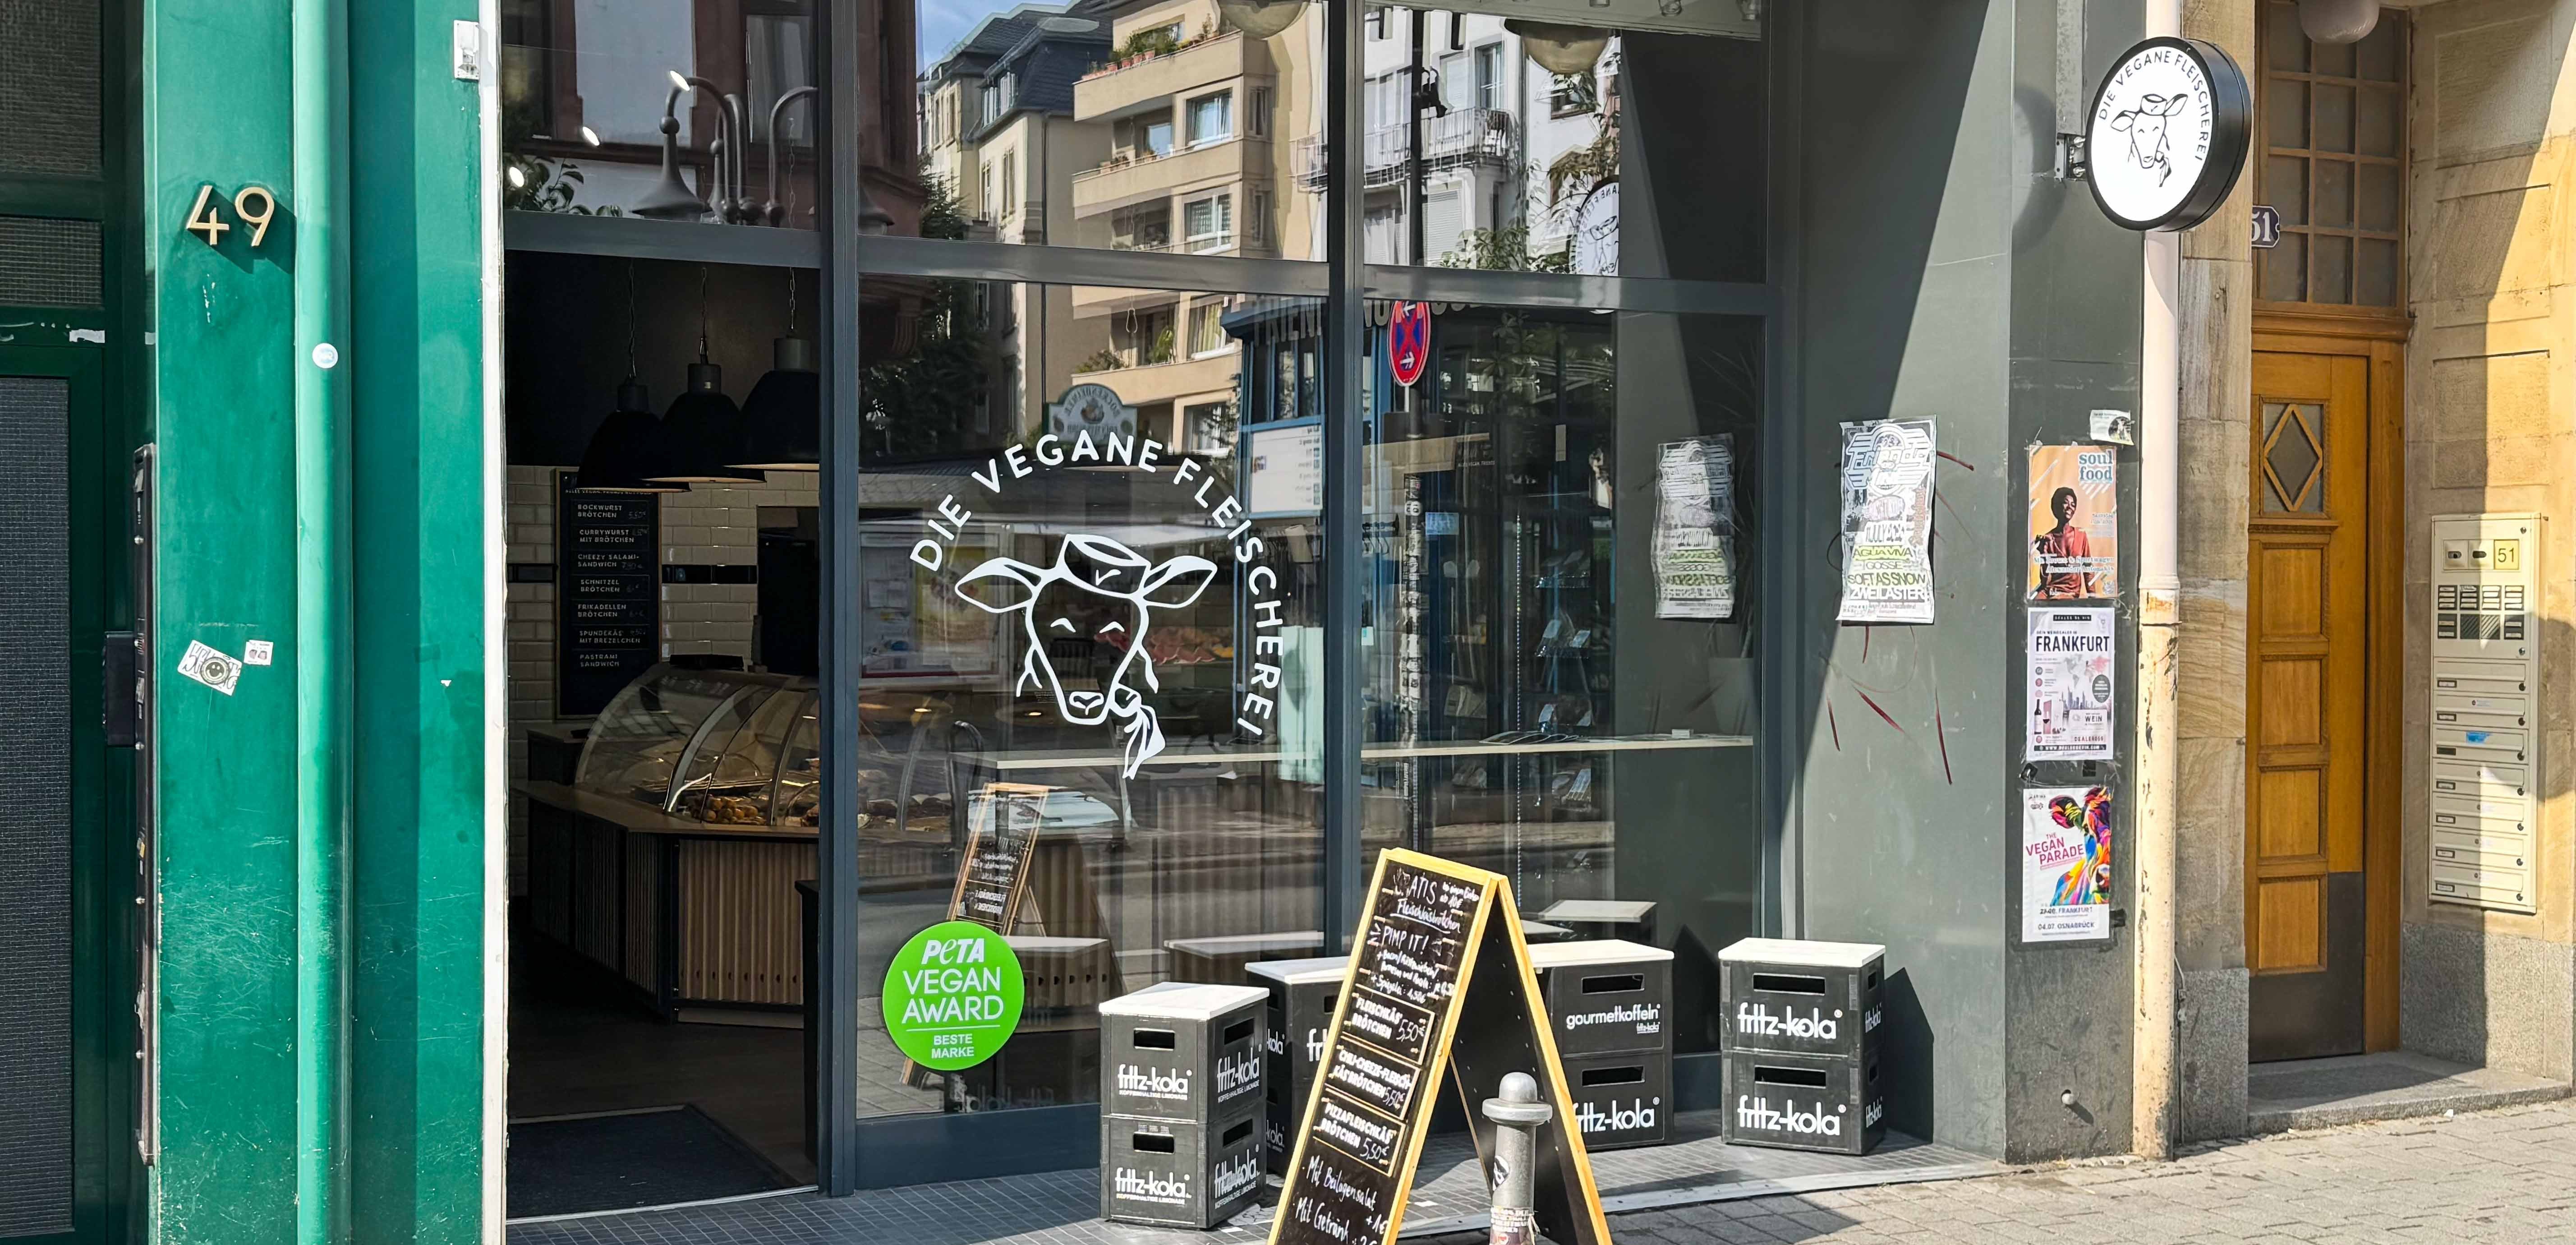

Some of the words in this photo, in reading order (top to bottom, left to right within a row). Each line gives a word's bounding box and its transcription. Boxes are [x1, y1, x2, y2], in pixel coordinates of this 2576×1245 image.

[2099, 90, 2116, 120] DIE
[2116, 50, 2171, 86] VEGANE
[2174, 54, 2210, 161] FLEISCHEREI
[187, 185, 275, 247] 49
[2251, 211, 2271, 242] 51
[2079, 450, 2113, 465] soul
[2079, 466, 2113, 482] food
[1853, 548, 1887, 558] AGUA
[1866, 561, 1904, 570] GOSSE
[2497, 547, 2515, 563] 51
[910, 494, 972, 572] DIE
[971, 429, 1163, 493] VEGANE
[1173, 457, 1283, 736] FLEISCHEREI
[2036, 636, 2110, 652] FRANKFURT
[2025, 837, 2065, 856] VEGAN
[2039, 844, 2084, 865] PARADE
[1381, 925, 1408, 950] PIMP
[2057, 921, 2095, 929] OSNABRÜCK
[902, 966, 1001, 995] VEGAN
[902, 995, 1004, 1024] AWARD
[1737, 1002, 1837, 1040] fritz-kola
[934, 1033, 973, 1046] BESTE
[1352, 1013, 1392, 1039] BRÖTCHEN
[931, 1046, 975, 1059] MARKE
[1118, 1063, 1189, 1094] fritz-kola
[1217, 1047, 1260, 1093] fritz-kola
[1737, 1094, 1840, 1136] fritz-kola
[1320, 1118, 1361, 1148] BRÖTCHEN
[1115, 1167, 1186, 1199] fritz-kola
[1306, 1154, 1324, 1187] Mit
[1295, 1197, 1313, 1223] Mit
[1314, 1202, 1350, 1244] Getränk
